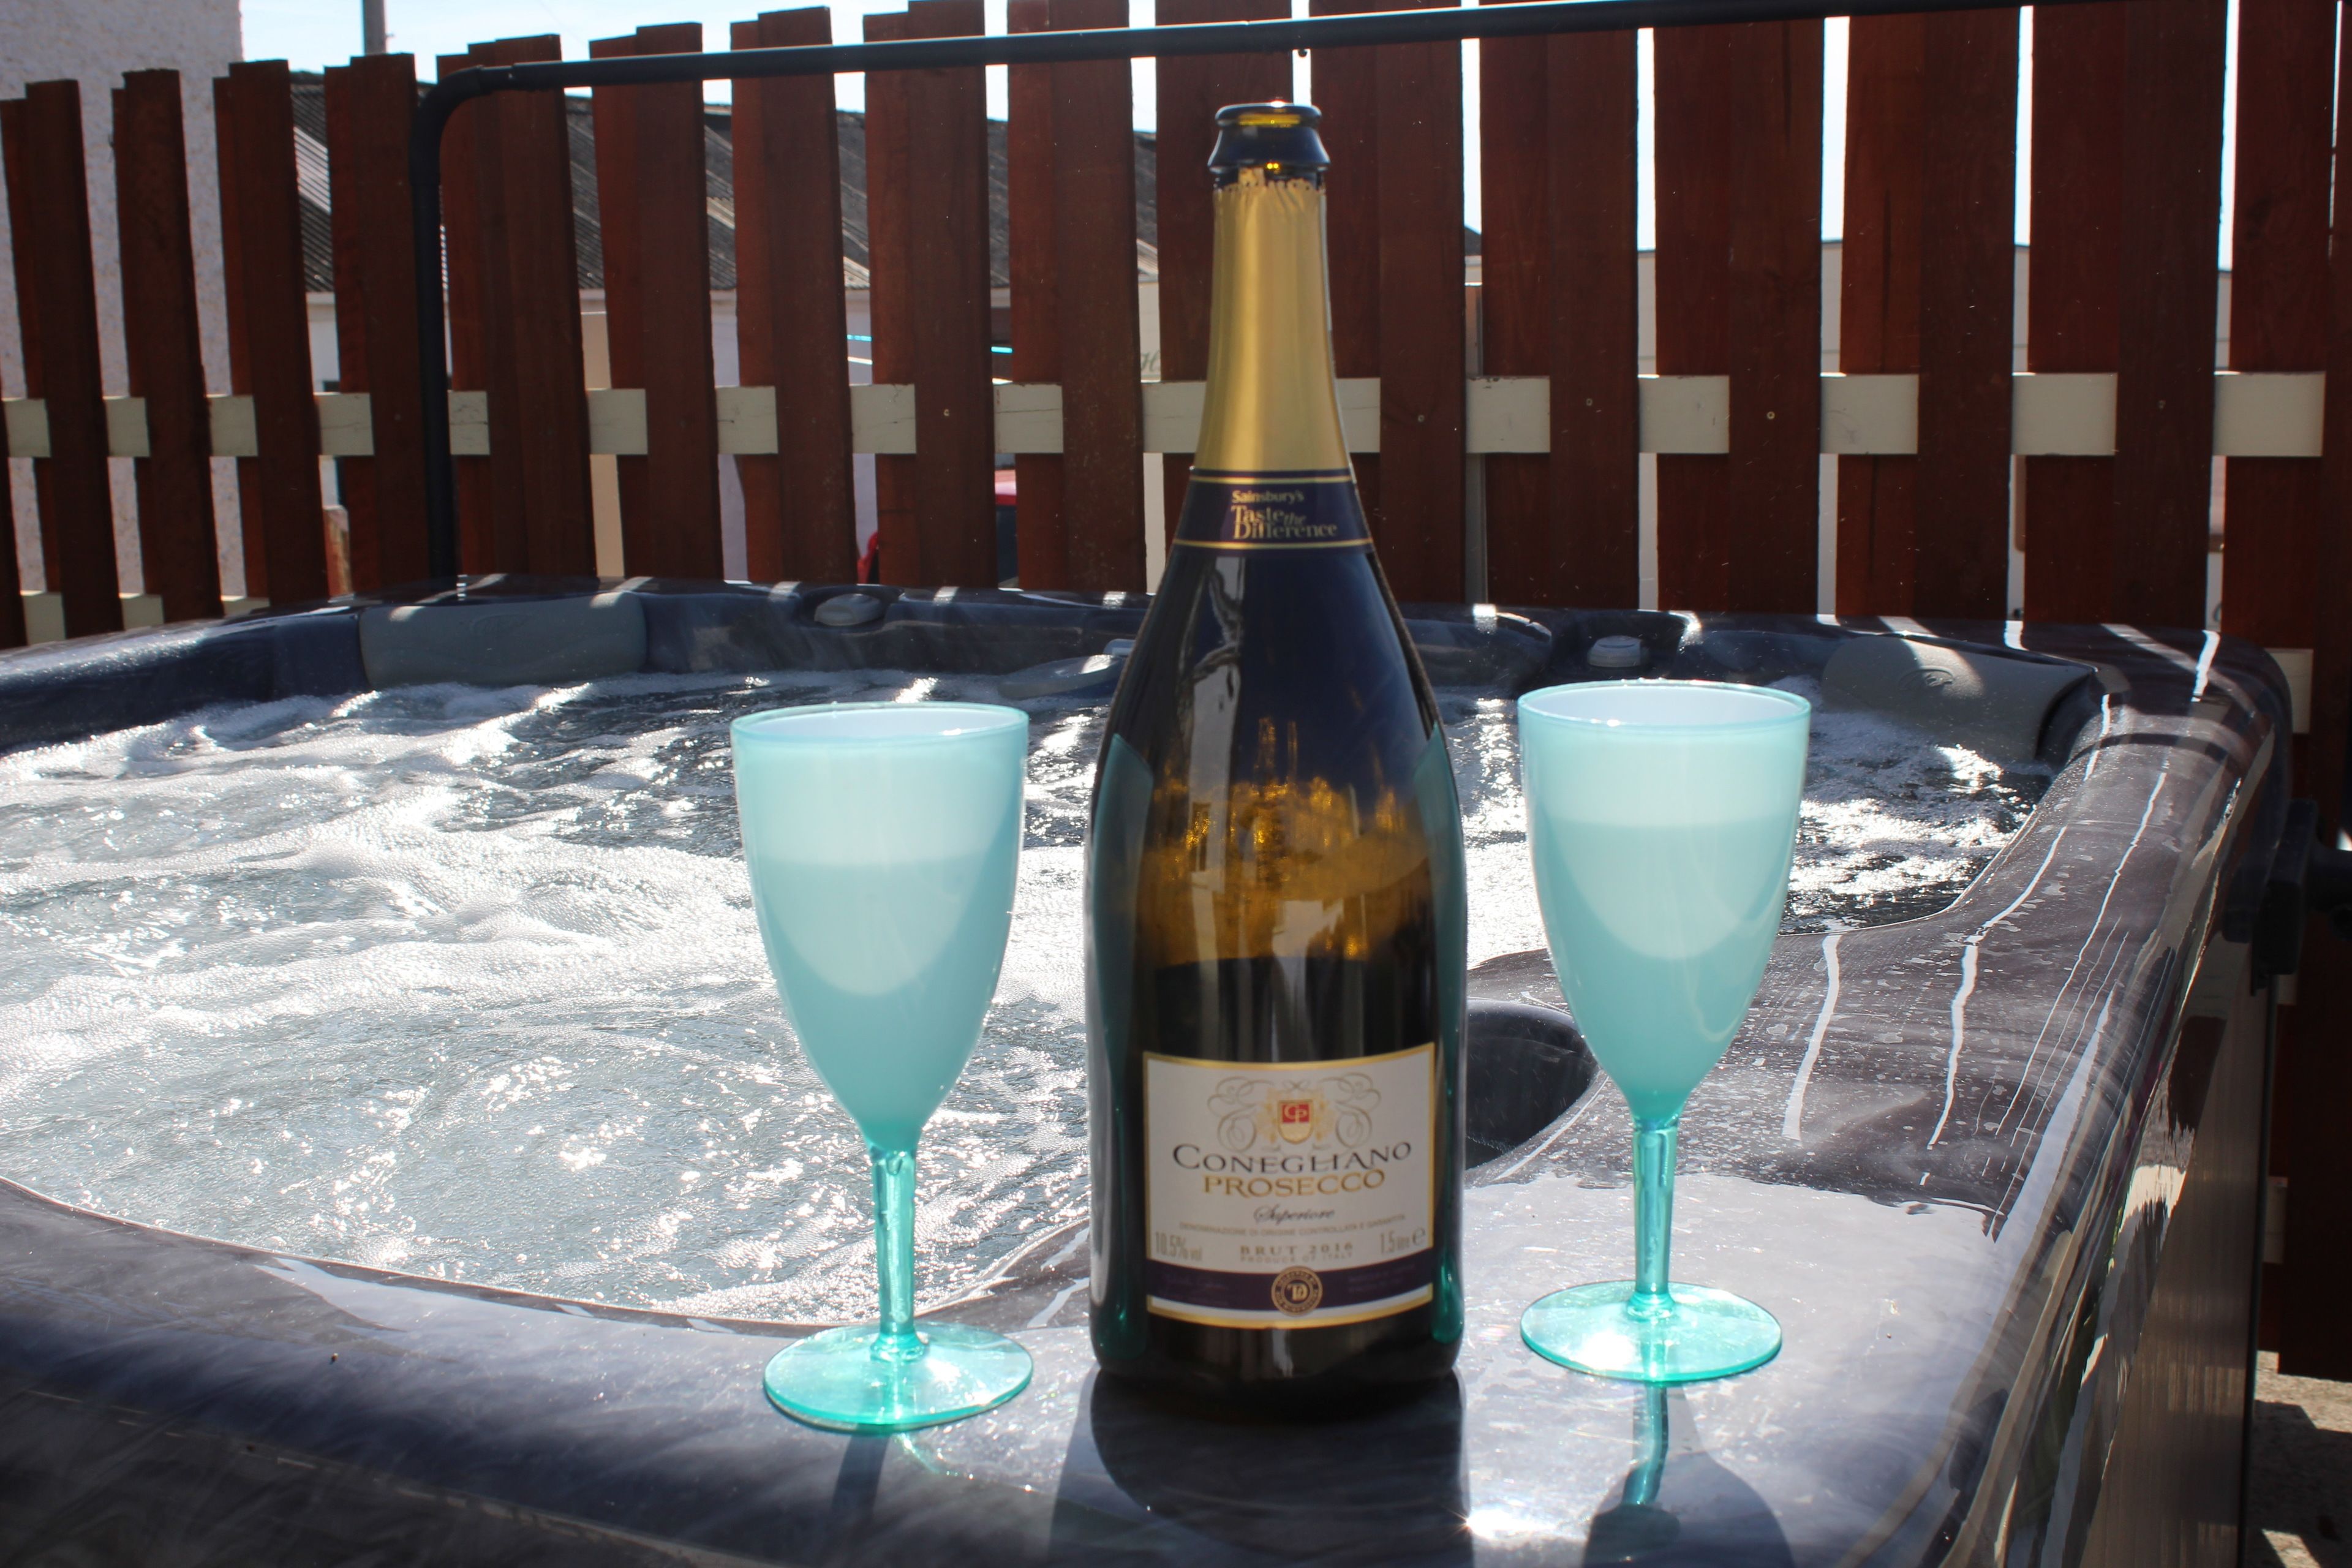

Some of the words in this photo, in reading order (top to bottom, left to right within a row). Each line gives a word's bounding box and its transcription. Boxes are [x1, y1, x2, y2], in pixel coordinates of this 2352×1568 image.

[1231, 489, 1305, 505] Sainsbury's
[1231, 504, 1285, 522] Taste
[1233, 521, 1338, 540] Difference
[1172, 1140, 1412, 1174] CONEGLIANO
[1202, 1168, 1386, 1199] PROSECCO
[1253, 1203, 1335, 1226] Superiore
[1240, 1244, 1297, 1256] BRUT
